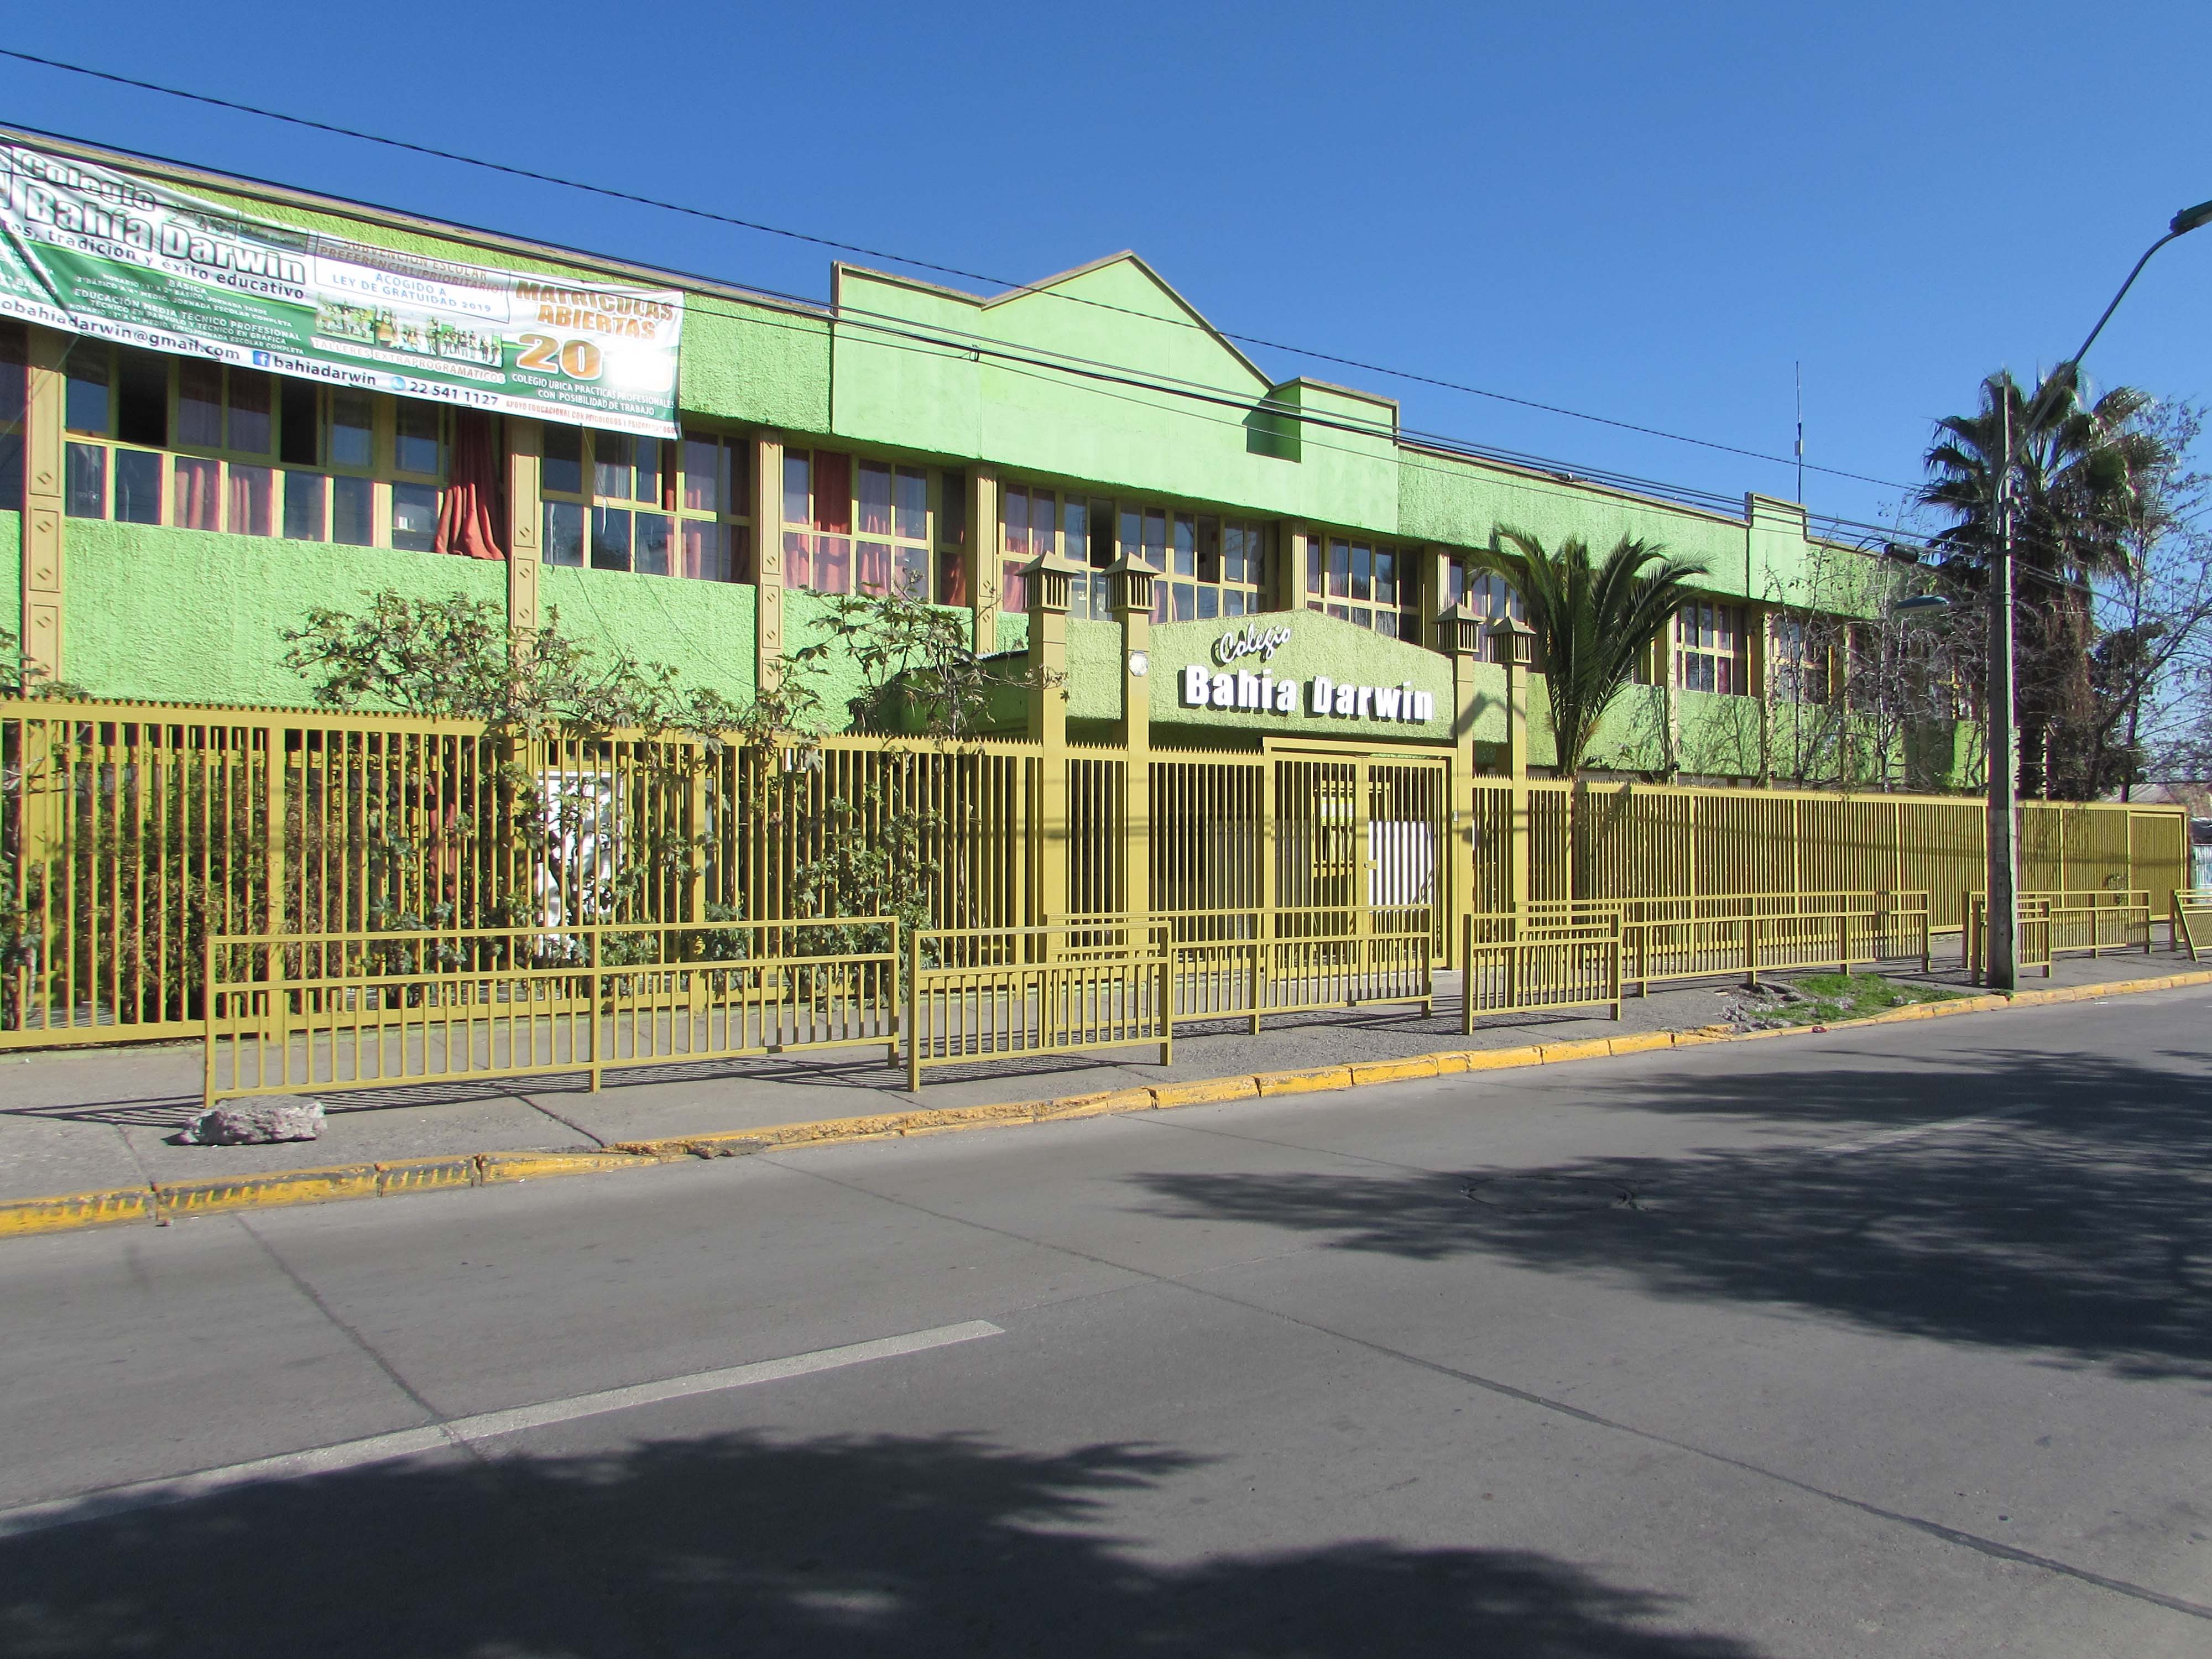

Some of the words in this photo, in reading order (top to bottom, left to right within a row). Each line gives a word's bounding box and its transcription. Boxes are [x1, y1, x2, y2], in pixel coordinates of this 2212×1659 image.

[48, 229, 136, 260] tradición
[144, 255, 154, 267] y
[216, 273, 304, 299] educativo
[160, 222, 305, 285] Darwin
[332, 274, 356, 287] LEY
[361, 280, 378, 293] DE
[382, 286, 457, 307] GRATUIDAD
[461, 301, 491, 312] 2019
[375, 273, 434, 294] ACOGIDO
[439, 288, 447, 296] A
[73, 288, 139, 307] EDUCACIÓN
[142, 301, 178, 318] MEDIA
[230, 319, 302, 341] PROFESIONAL
[208, 296, 243, 310] JORNADA
[213, 303, 250, 318] ESCOLAR
[252, 314, 293, 328] COMPLETA
[236, 328, 248, 337] EN
[538, 305, 656, 340] ABIERTAS
[229, 336, 264, 348] ESCOLAR
[265, 342, 305, 355] COMPLETA
[314, 338, 372, 358] TALLERES
[373, 349, 505, 384] EXTRAPROGRAMATICOS
[274, 356, 377, 385] bahiadarwin
[410, 381, 427, 394] 22
[432, 386, 458, 399] 541
[465, 390, 498, 406] 1127
[512, 373, 547, 388] COLEGIO
[548, 379, 573, 392] UBICA
[574, 384, 617, 399] PRACTICAS
[617, 391, 675, 410] PROFESIONALES
[538, 389, 556, 399] CON
[559, 392, 608, 409] POSIBILIDAD
[609, 400, 619, 411] DE
[619, 403, 655, 416] TRABAJO
[505, 400, 526, 410] APOYO
[528, 404, 571, 419] EDUCACIONAL
[572, 411, 584, 420] CON
[1218, 622, 1292, 664] Colegio
[1311, 675, 1433, 721] Darwin
